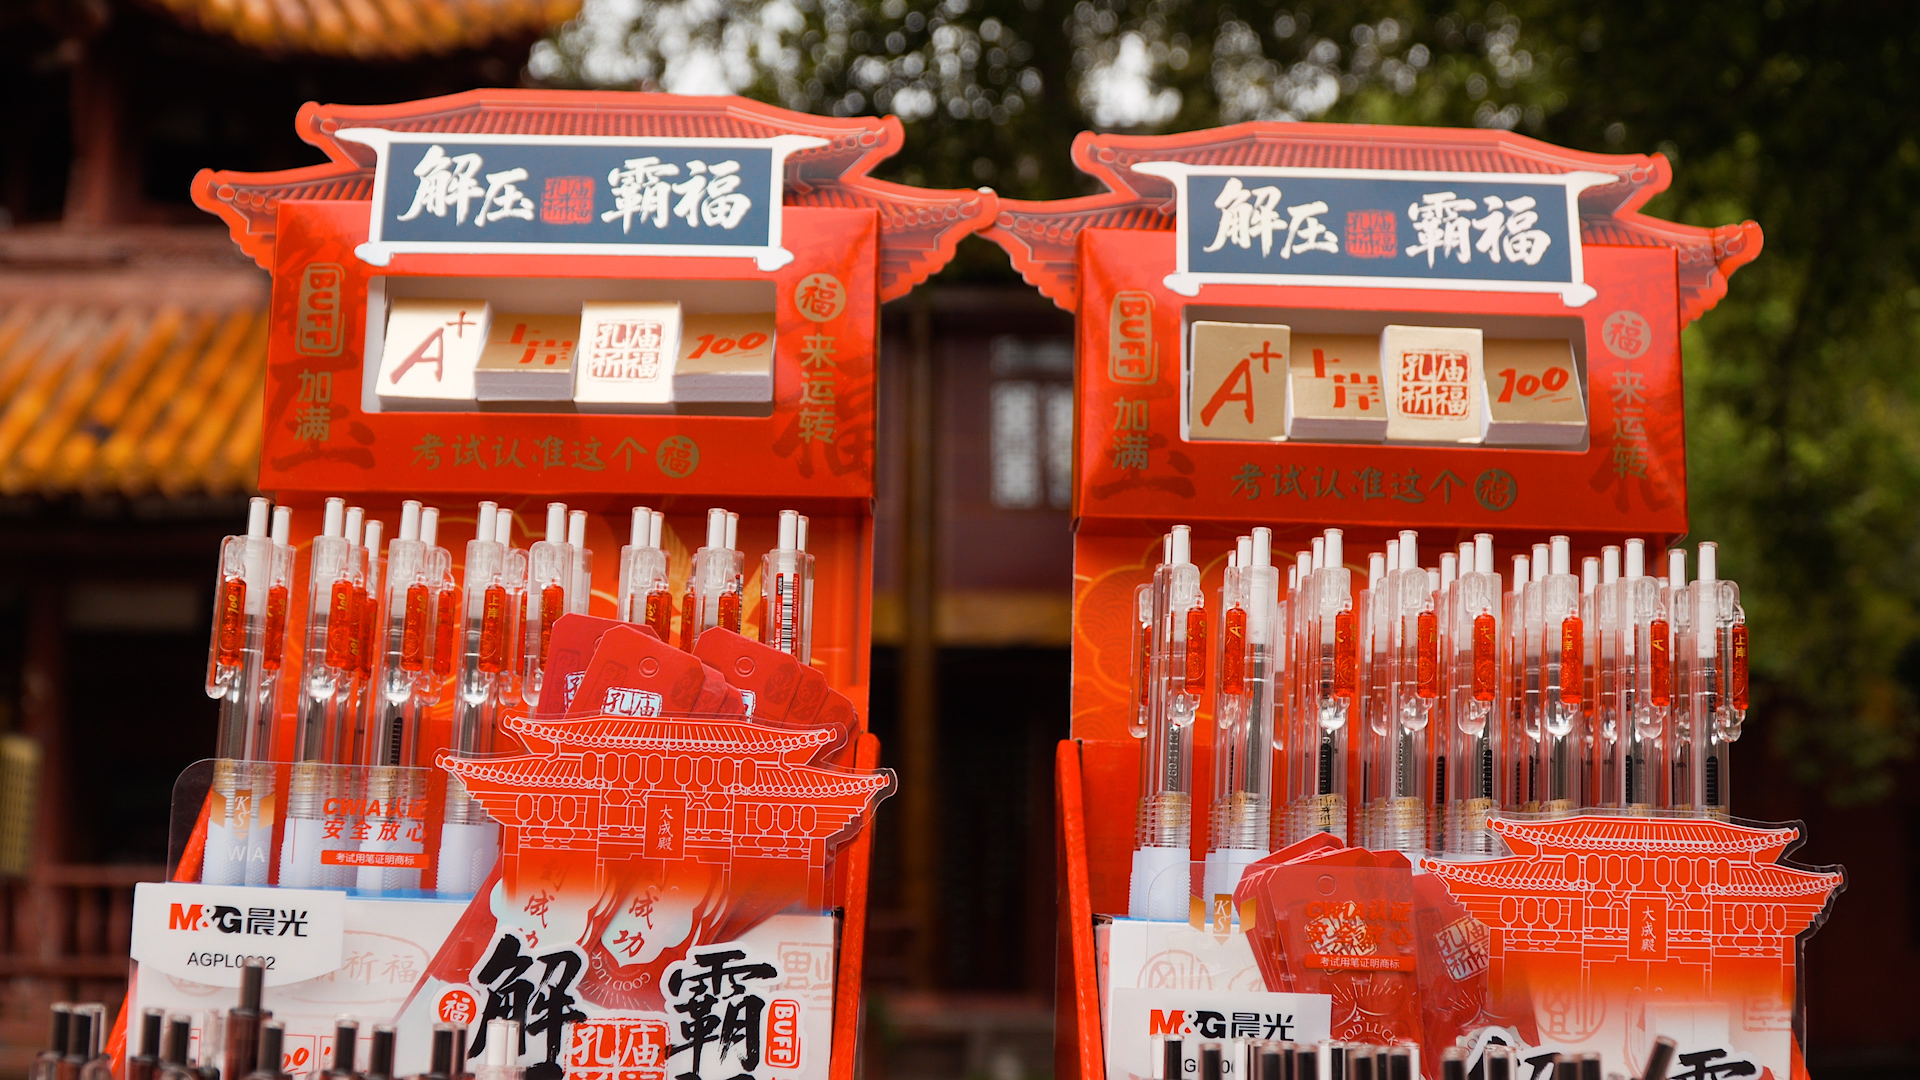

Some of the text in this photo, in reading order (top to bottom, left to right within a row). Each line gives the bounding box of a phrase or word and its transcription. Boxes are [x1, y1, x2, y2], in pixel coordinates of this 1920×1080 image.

[397, 144, 752, 234] 解压 霸福
[1203, 177, 1551, 269] 解压 霸福
[305, 271, 337, 348] BUFF
[390, 311, 477, 385] A+
[491, 323, 573, 366] 上岸
[687, 331, 768, 360] 100
[1118, 299, 1148, 375] BUFF
[1200, 341, 1283, 427] A+
[1297, 348, 1381, 411] 上岸
[1497, 366, 1570, 404] 100
[294, 368, 332, 442] 加满
[411, 432, 698, 478] 考试认准这个福
[1113, 396, 1149, 470] 加满
[1230, 461, 1516, 511] 考试认准这个福
[227, 594, 239, 614] 100
[337, 593, 348, 612] 100
[321, 820, 428, 843] 安全放心
[656, 802, 674, 852] 大成殿
[334, 853, 415, 866] 考试用笔证明商标
[1305, 923, 1412, 946] 安全放心
[1641, 905, 1657, 954] 大成殿
[612, 972, 651, 992] GOOD
[1319, 956, 1400, 969] 考试用笔证明商标
[467, 933, 586, 1080] 解
[664, 949, 778, 1080] 霸
[573, 1022, 660, 1067] 孔庙
[772, 1004, 794, 1065] BUFF
